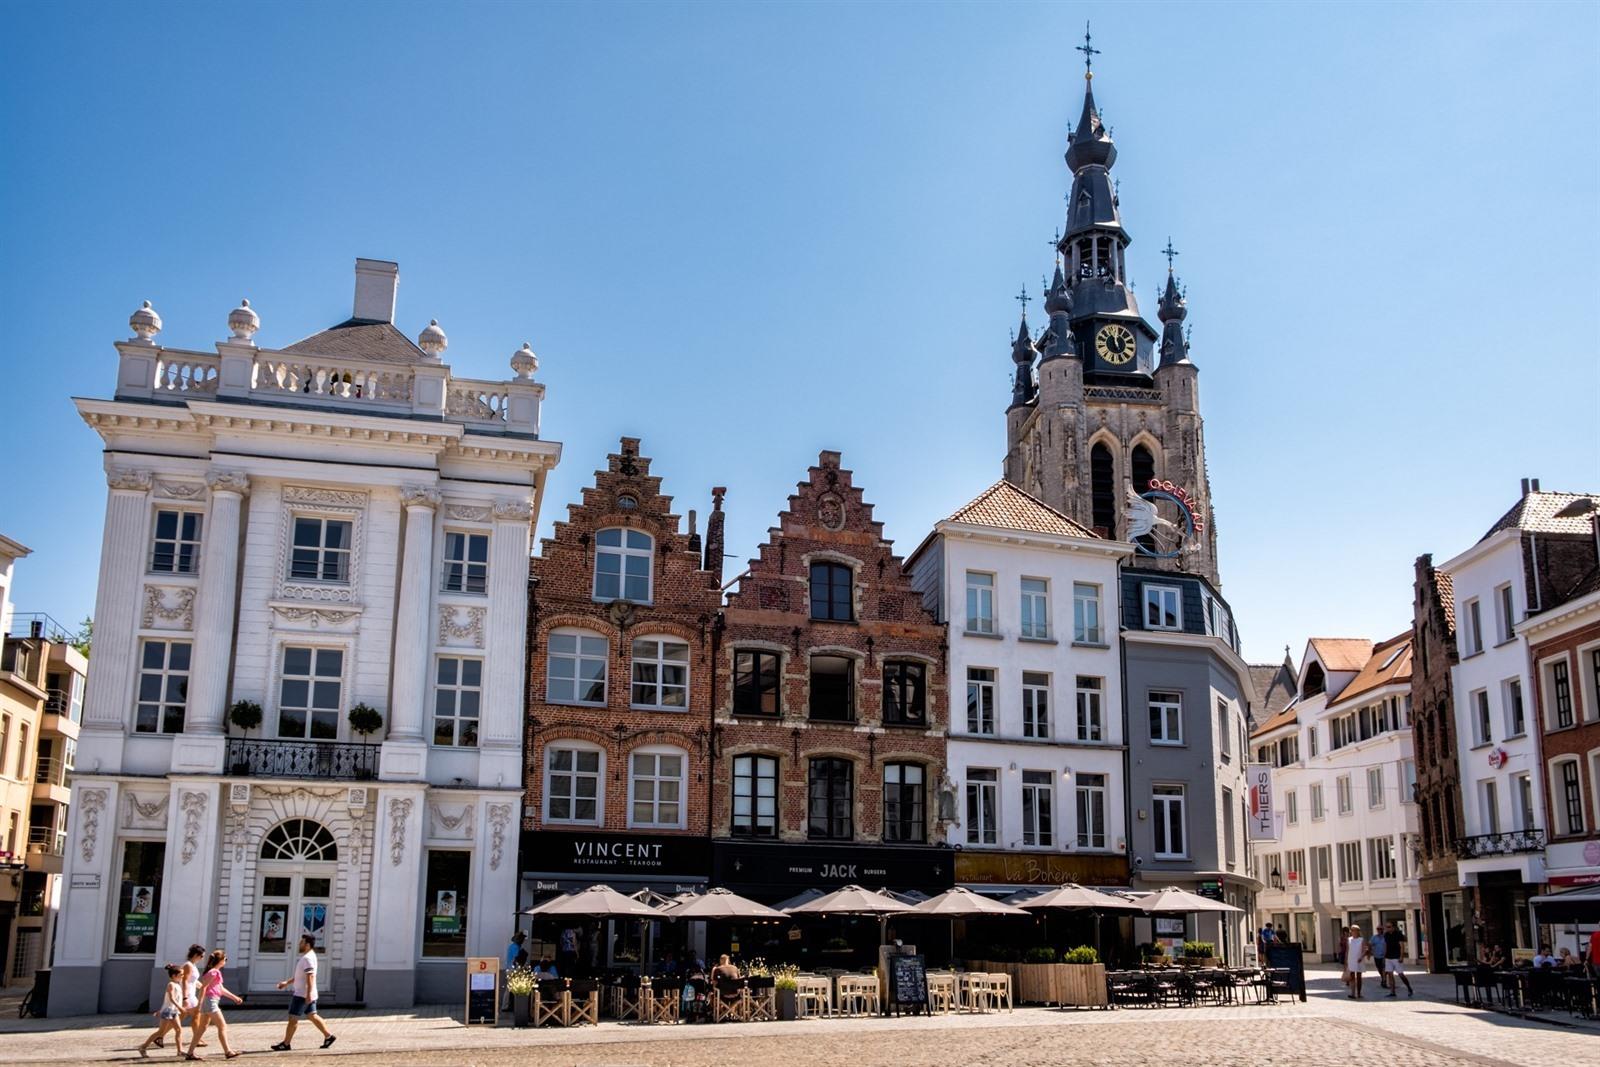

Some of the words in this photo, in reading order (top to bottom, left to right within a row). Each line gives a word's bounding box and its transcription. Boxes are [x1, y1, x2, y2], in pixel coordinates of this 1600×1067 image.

[1258, 772, 1270, 832] THIERS
[574, 842, 662, 858] VINCENT
[820, 864, 857, 878] JACK
[1003, 857, 1023, 881] La
[1026, 857, 1080, 882] Bohème
[537, 881, 558, 890] Duvel
[676, 884, 696, 893] Duvel
